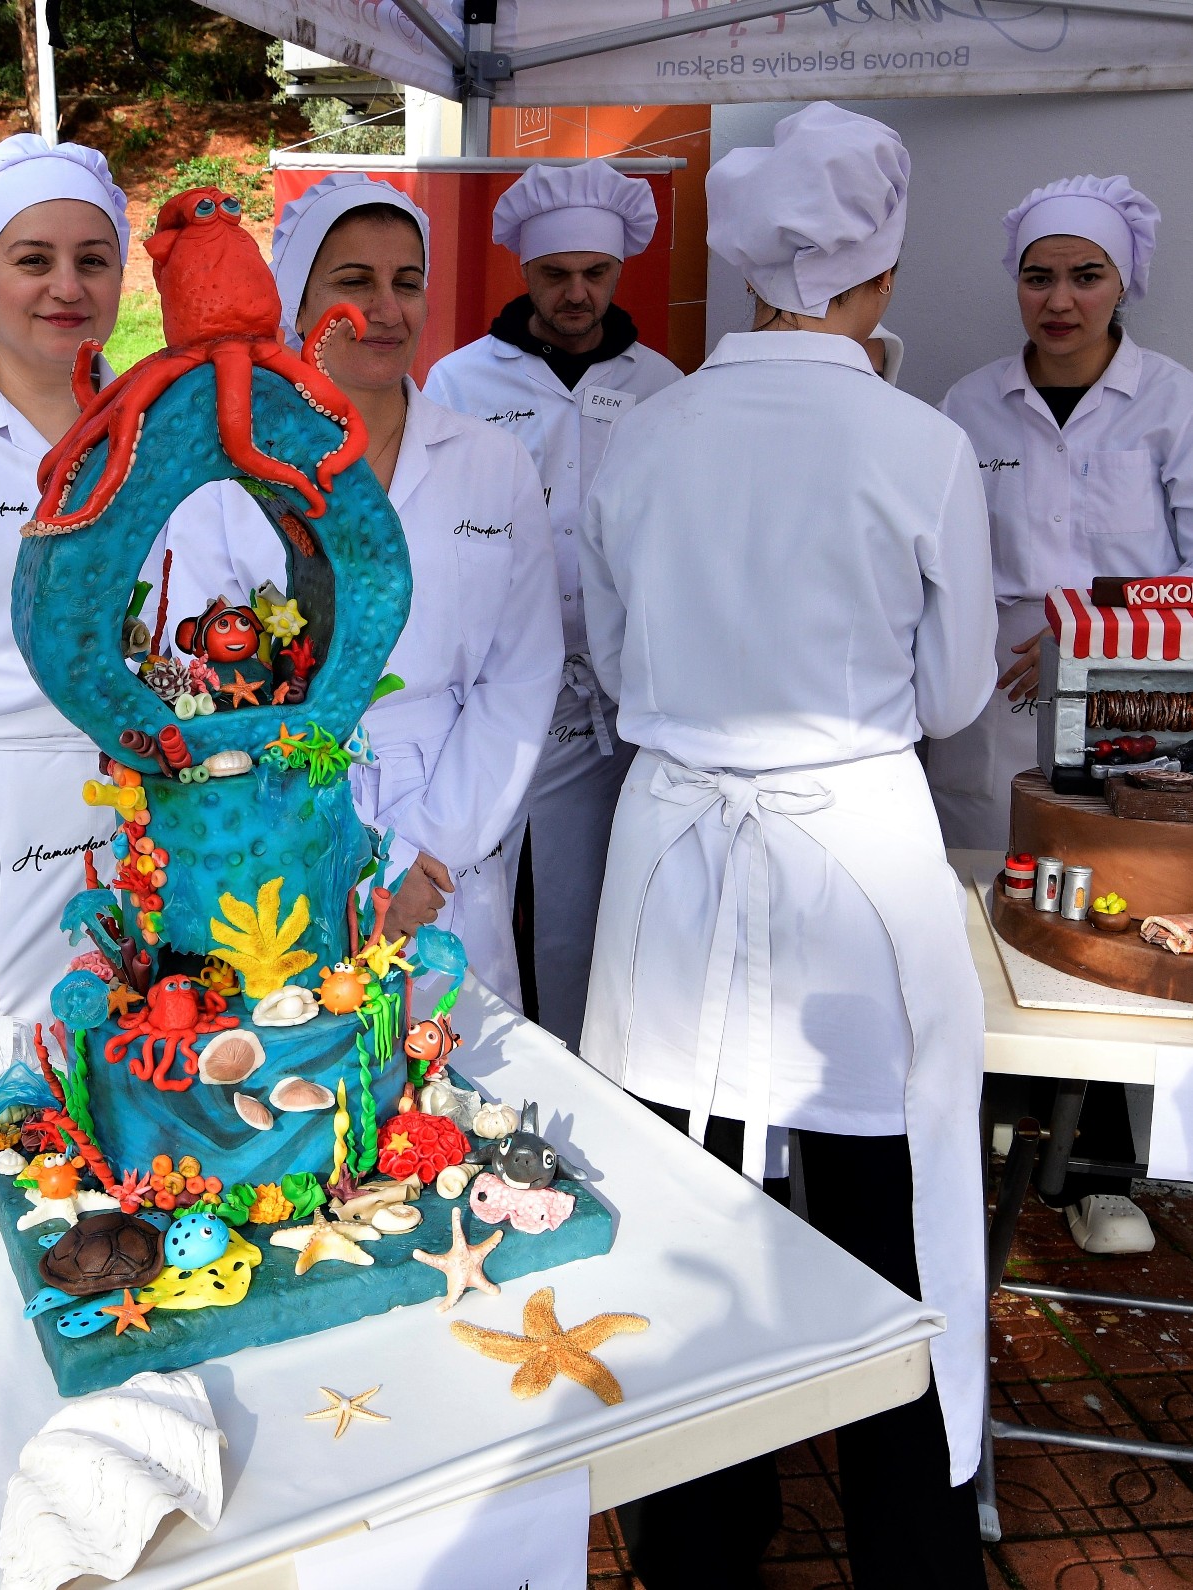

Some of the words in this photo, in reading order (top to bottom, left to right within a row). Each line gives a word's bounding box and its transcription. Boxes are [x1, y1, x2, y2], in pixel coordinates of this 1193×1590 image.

[591, 394, 623, 408] EREN
[1127, 583, 1193, 606] KOKO
[12, 836, 108, 872] Hamurdan
